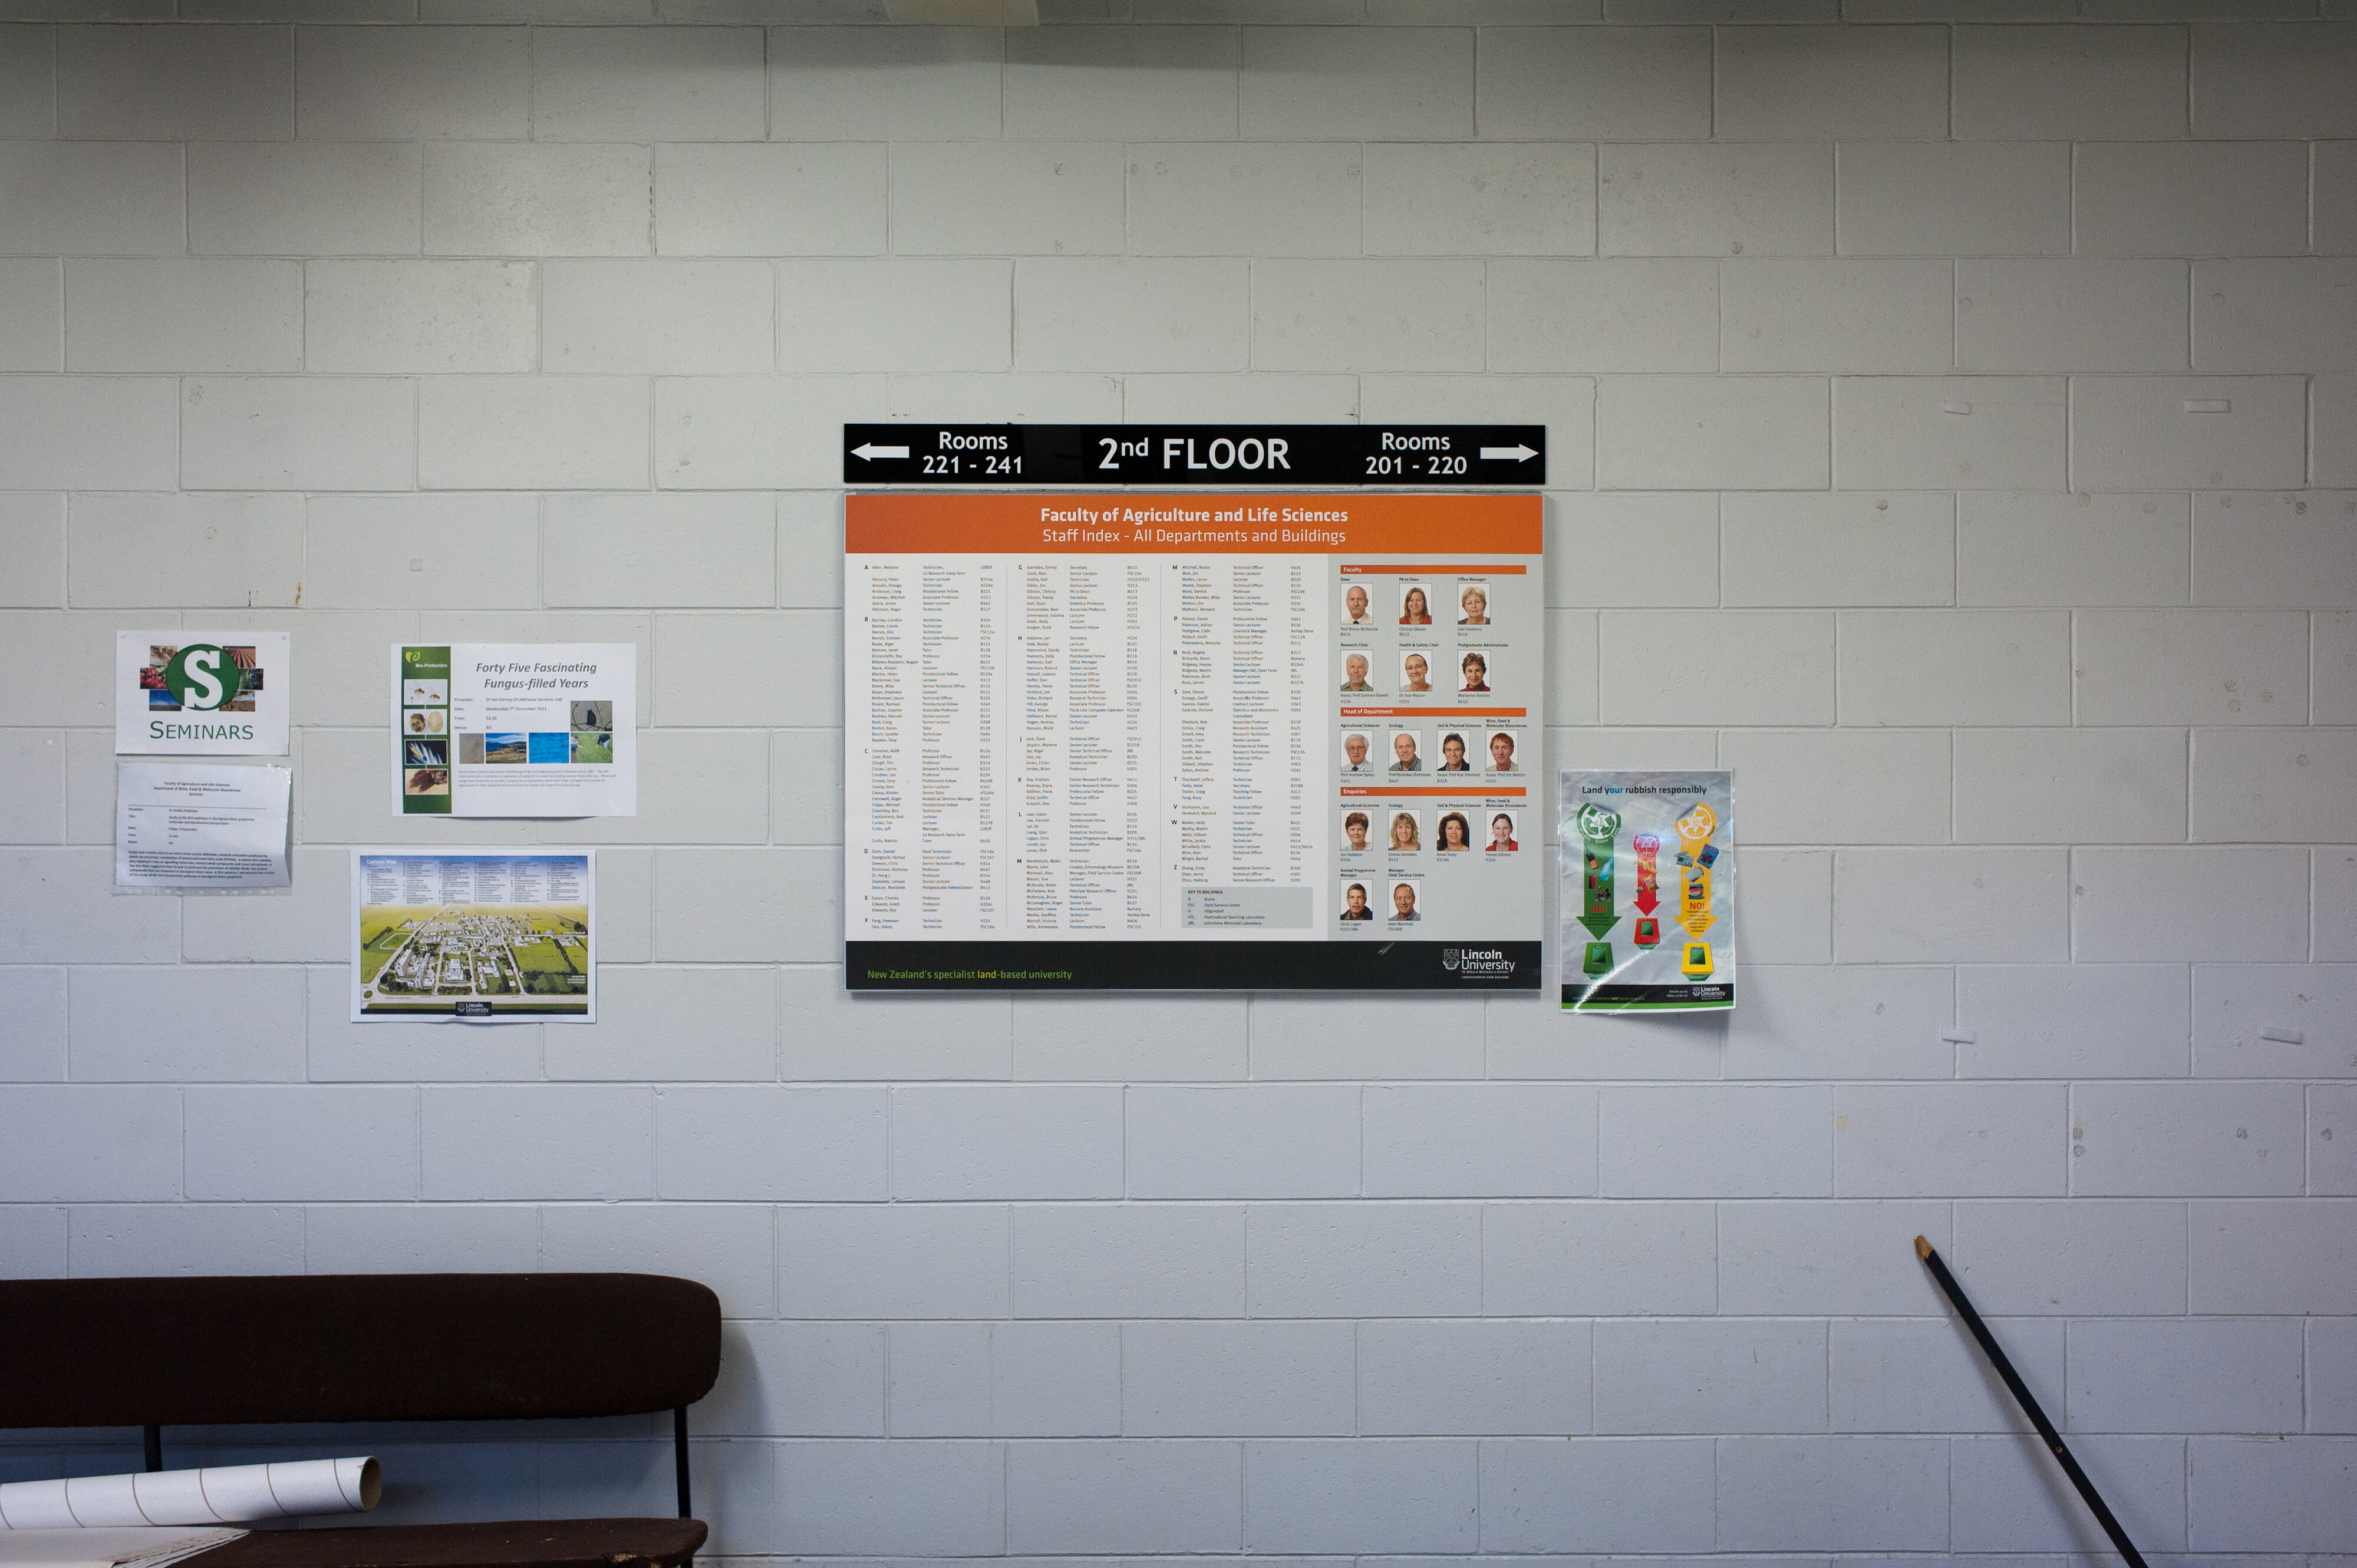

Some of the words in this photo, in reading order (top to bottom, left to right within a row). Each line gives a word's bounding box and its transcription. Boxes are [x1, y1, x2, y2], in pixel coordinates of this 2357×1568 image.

[939, 431, 1008, 450] Rooms
[1383, 433, 1450, 450] Rooms
[1099, 437, 1148, 469] 2nd
[1164, 438, 1291, 469] FLOOR
[923, 455, 958, 473] 221
[985, 456, 1021, 474] 241
[1366, 456, 1401, 474] 201
[1429, 456, 1466, 474] 220
[1041, 508, 1098, 524] Faculty
[1103, 508, 1119, 521] of
[1123, 508, 1209, 524] Agriculture
[1215, 508, 1242, 521] and
[1248, 508, 1277, 521] Life
[1283, 508, 1347, 521] Sciences
[1043, 529, 1079, 542] Staff
[1083, 529, 1119, 542] Index
[1134, 529, 1151, 542] All
[1157, 529, 1247, 544] Departments
[1252, 529, 1277, 542] and
[1283, 529, 1345, 545] Buildings
[476, 663, 505, 674] Forty
[509, 663, 530, 672] Five
[534, 663, 596, 674] Fascinating
[184, 650, 223, 709] S
[484, 679, 556, 690] Fungus-filled
[560, 679, 588, 688] Years
[1659, 785, 1706, 795] responsibly
[1462, 949, 1502, 959] Lincoln
[1462, 960, 1515, 972] University
[934, 970, 975, 980] specialist
[978, 970, 1026, 978] land-based
[1029, 970, 1072, 979] university
